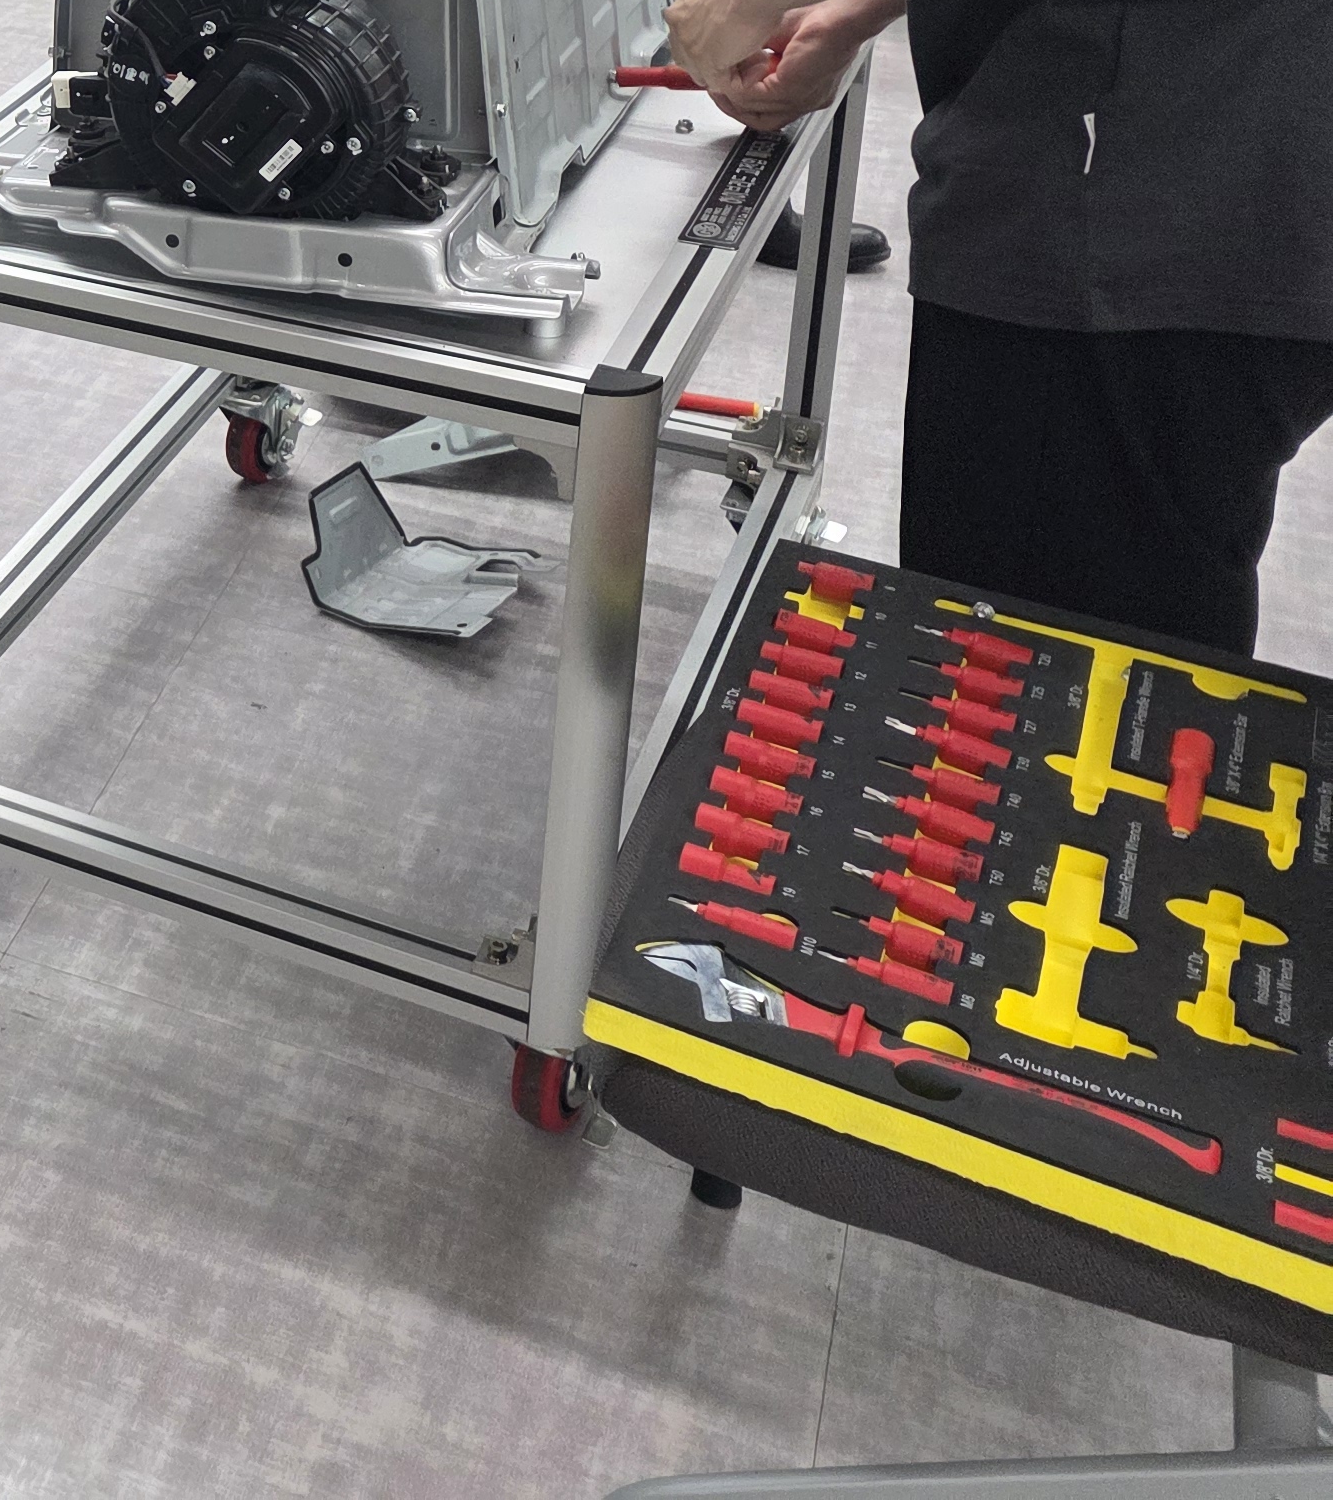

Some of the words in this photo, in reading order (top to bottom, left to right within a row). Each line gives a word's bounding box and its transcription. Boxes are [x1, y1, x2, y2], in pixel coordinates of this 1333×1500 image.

[855, 671, 867, 681] 12
[843, 702, 856, 712] 13
[1023, 719, 1037, 735] T27
[833, 735, 846, 745] 14
[821, 769, 835, 780] 15
[1007, 793, 1022, 808] T40
[809, 806, 823, 816] 16
[998, 830, 1014, 847] T45
[796, 844, 810, 855] 17
[989, 869, 1005, 886] T50
[782, 886, 796, 898] 19
[980, 911, 995, 926] M5
[800, 936, 818, 956] M10
[969, 952, 986, 968] M6
[960, 994, 976, 1010] M8
[999, 1052, 1101, 1093] Adjustable
[1107, 1086, 1183, 1120] Wrench
[1256, 1147, 1274, 1163] Dr.
[1256, 1160, 1273, 1184] 3/8"
